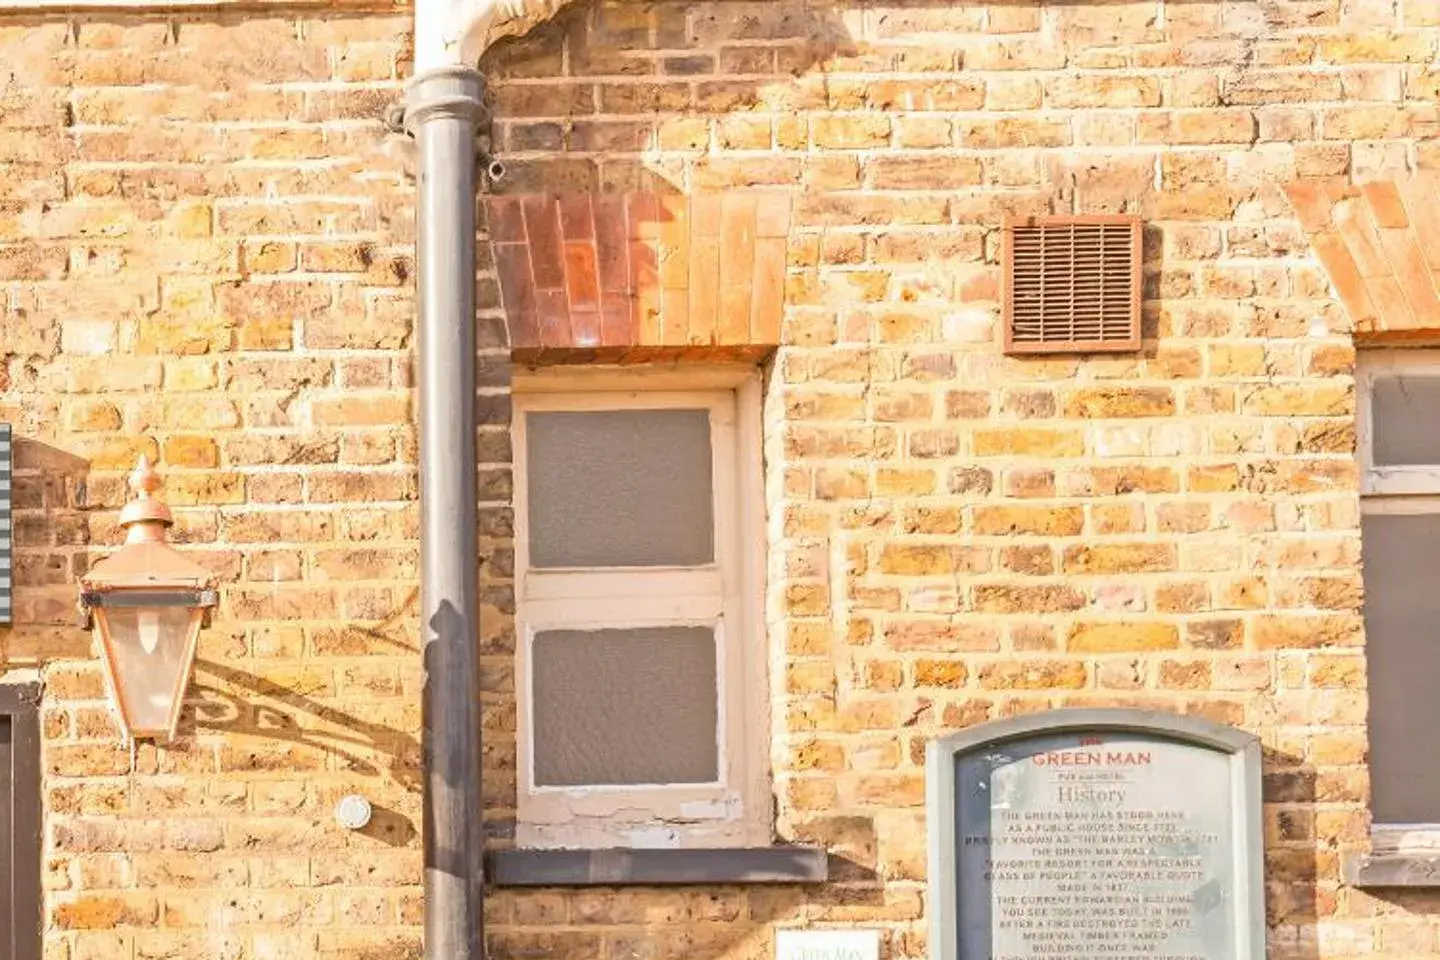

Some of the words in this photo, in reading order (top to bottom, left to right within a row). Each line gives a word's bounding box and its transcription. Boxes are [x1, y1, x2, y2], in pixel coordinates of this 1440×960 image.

[1032, 751, 1101, 766] GREEN
[1105, 751, 1152, 765] MAN
[1057, 785, 1126, 805] History
